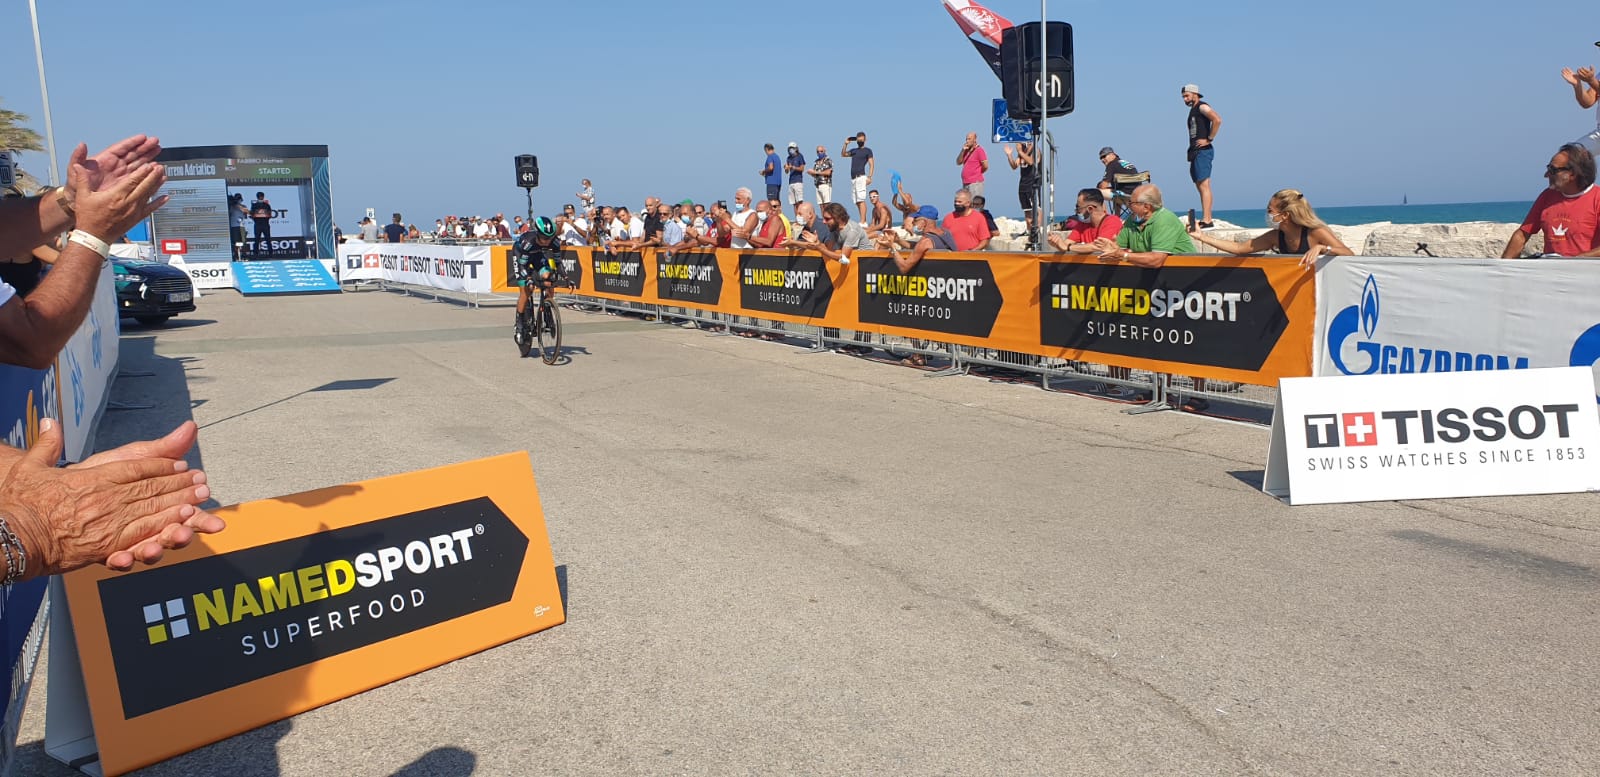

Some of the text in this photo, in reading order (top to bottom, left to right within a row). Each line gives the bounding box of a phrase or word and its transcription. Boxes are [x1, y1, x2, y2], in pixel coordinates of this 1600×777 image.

[184, 163, 216, 176] Adriatico
[258, 167, 291, 175] STARTED
[189, 268, 228, 278] SSOT
[760, 291, 800, 305] SUPERFOOD
[887, 302, 951, 320] SUPERFOOD
[1087, 320, 1195, 346] SUPERFOOD
[1381, 404, 1579, 445] TISSOT
[1307, 447, 1586, 471] SWISS WATCHES SINCE 1853
[240, 588, 425, 656] SUPERFOOD
